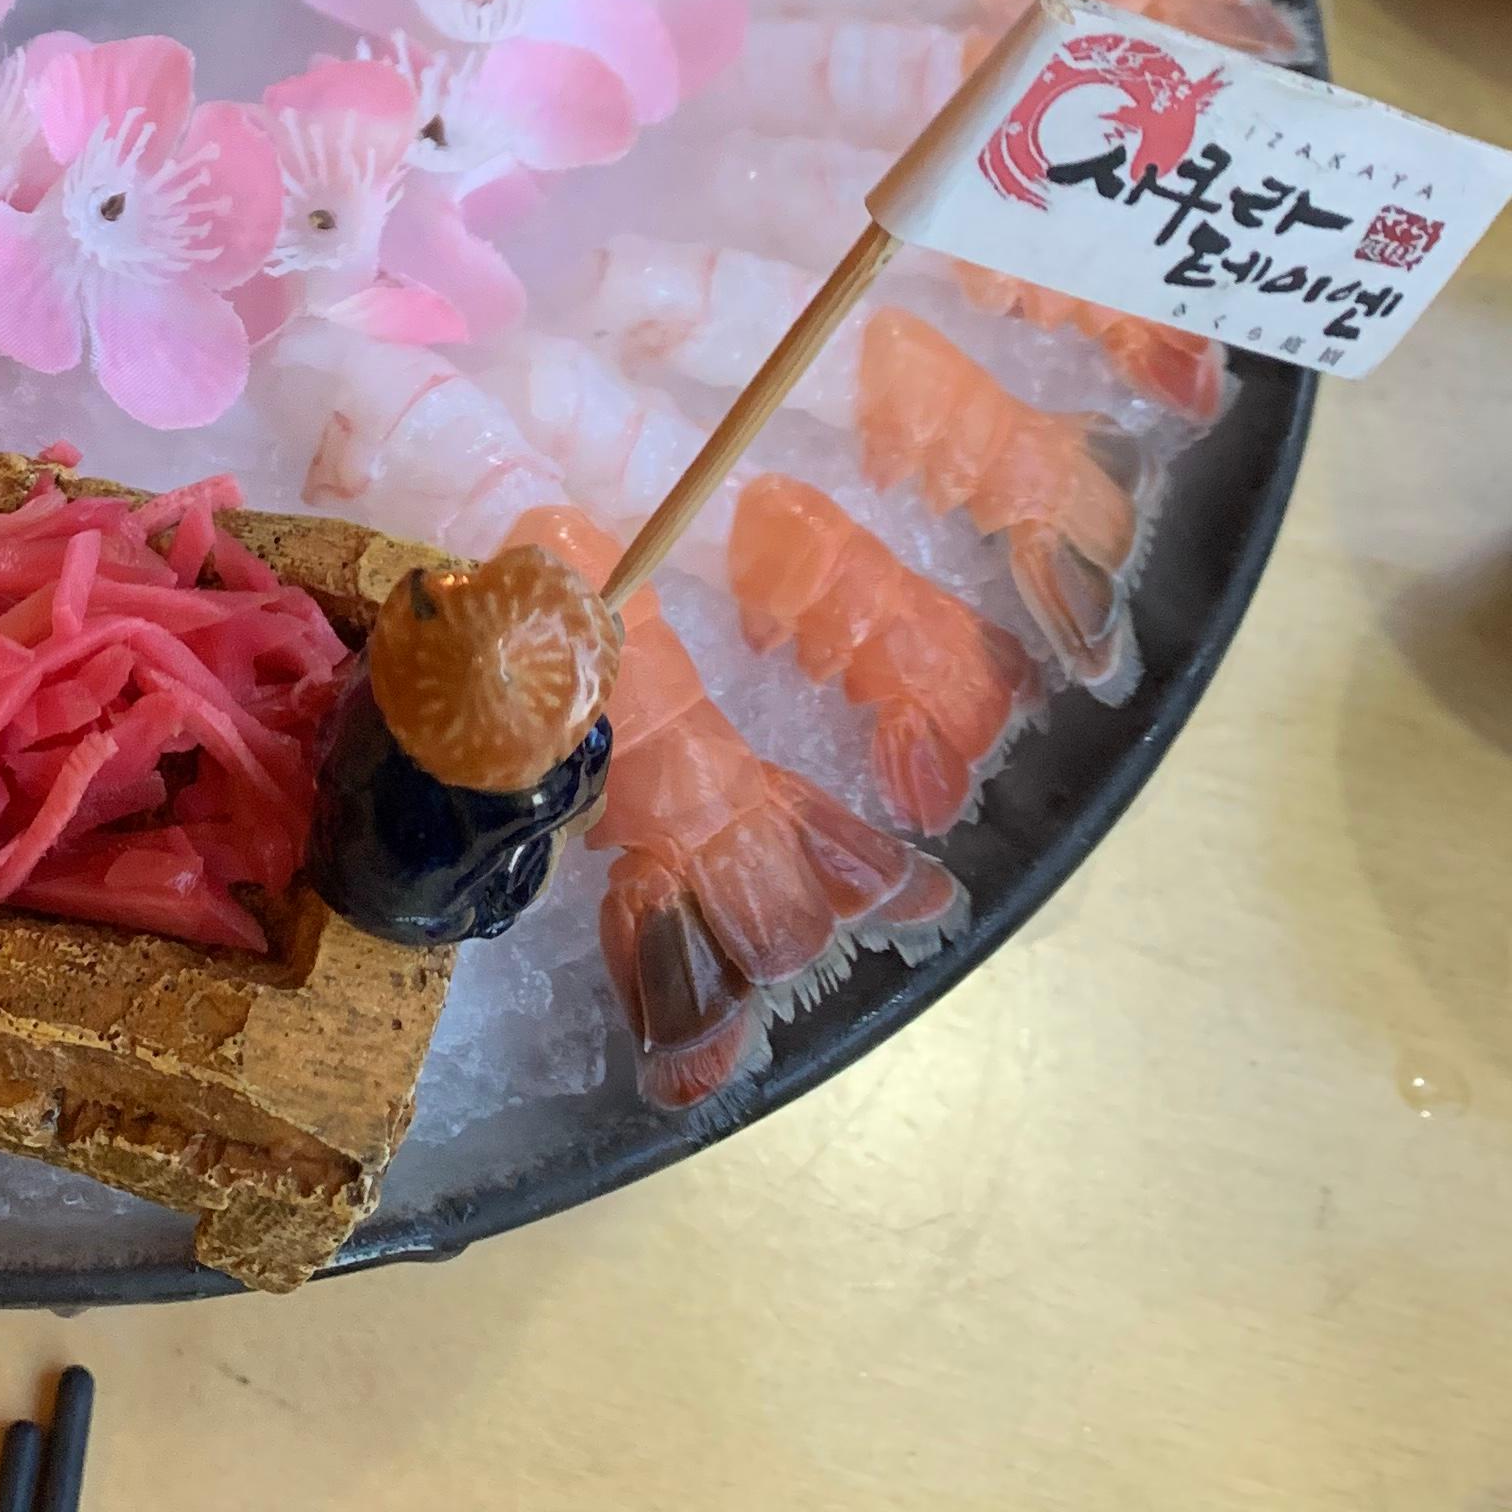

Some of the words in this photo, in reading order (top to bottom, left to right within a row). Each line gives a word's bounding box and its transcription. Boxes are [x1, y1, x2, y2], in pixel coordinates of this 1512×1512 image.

[1045, 141, 1354, 247] 사쿠라
[1244, 123, 1436, 200] IZAKAYA
[1162, 220, 1405, 340] 테이엔
